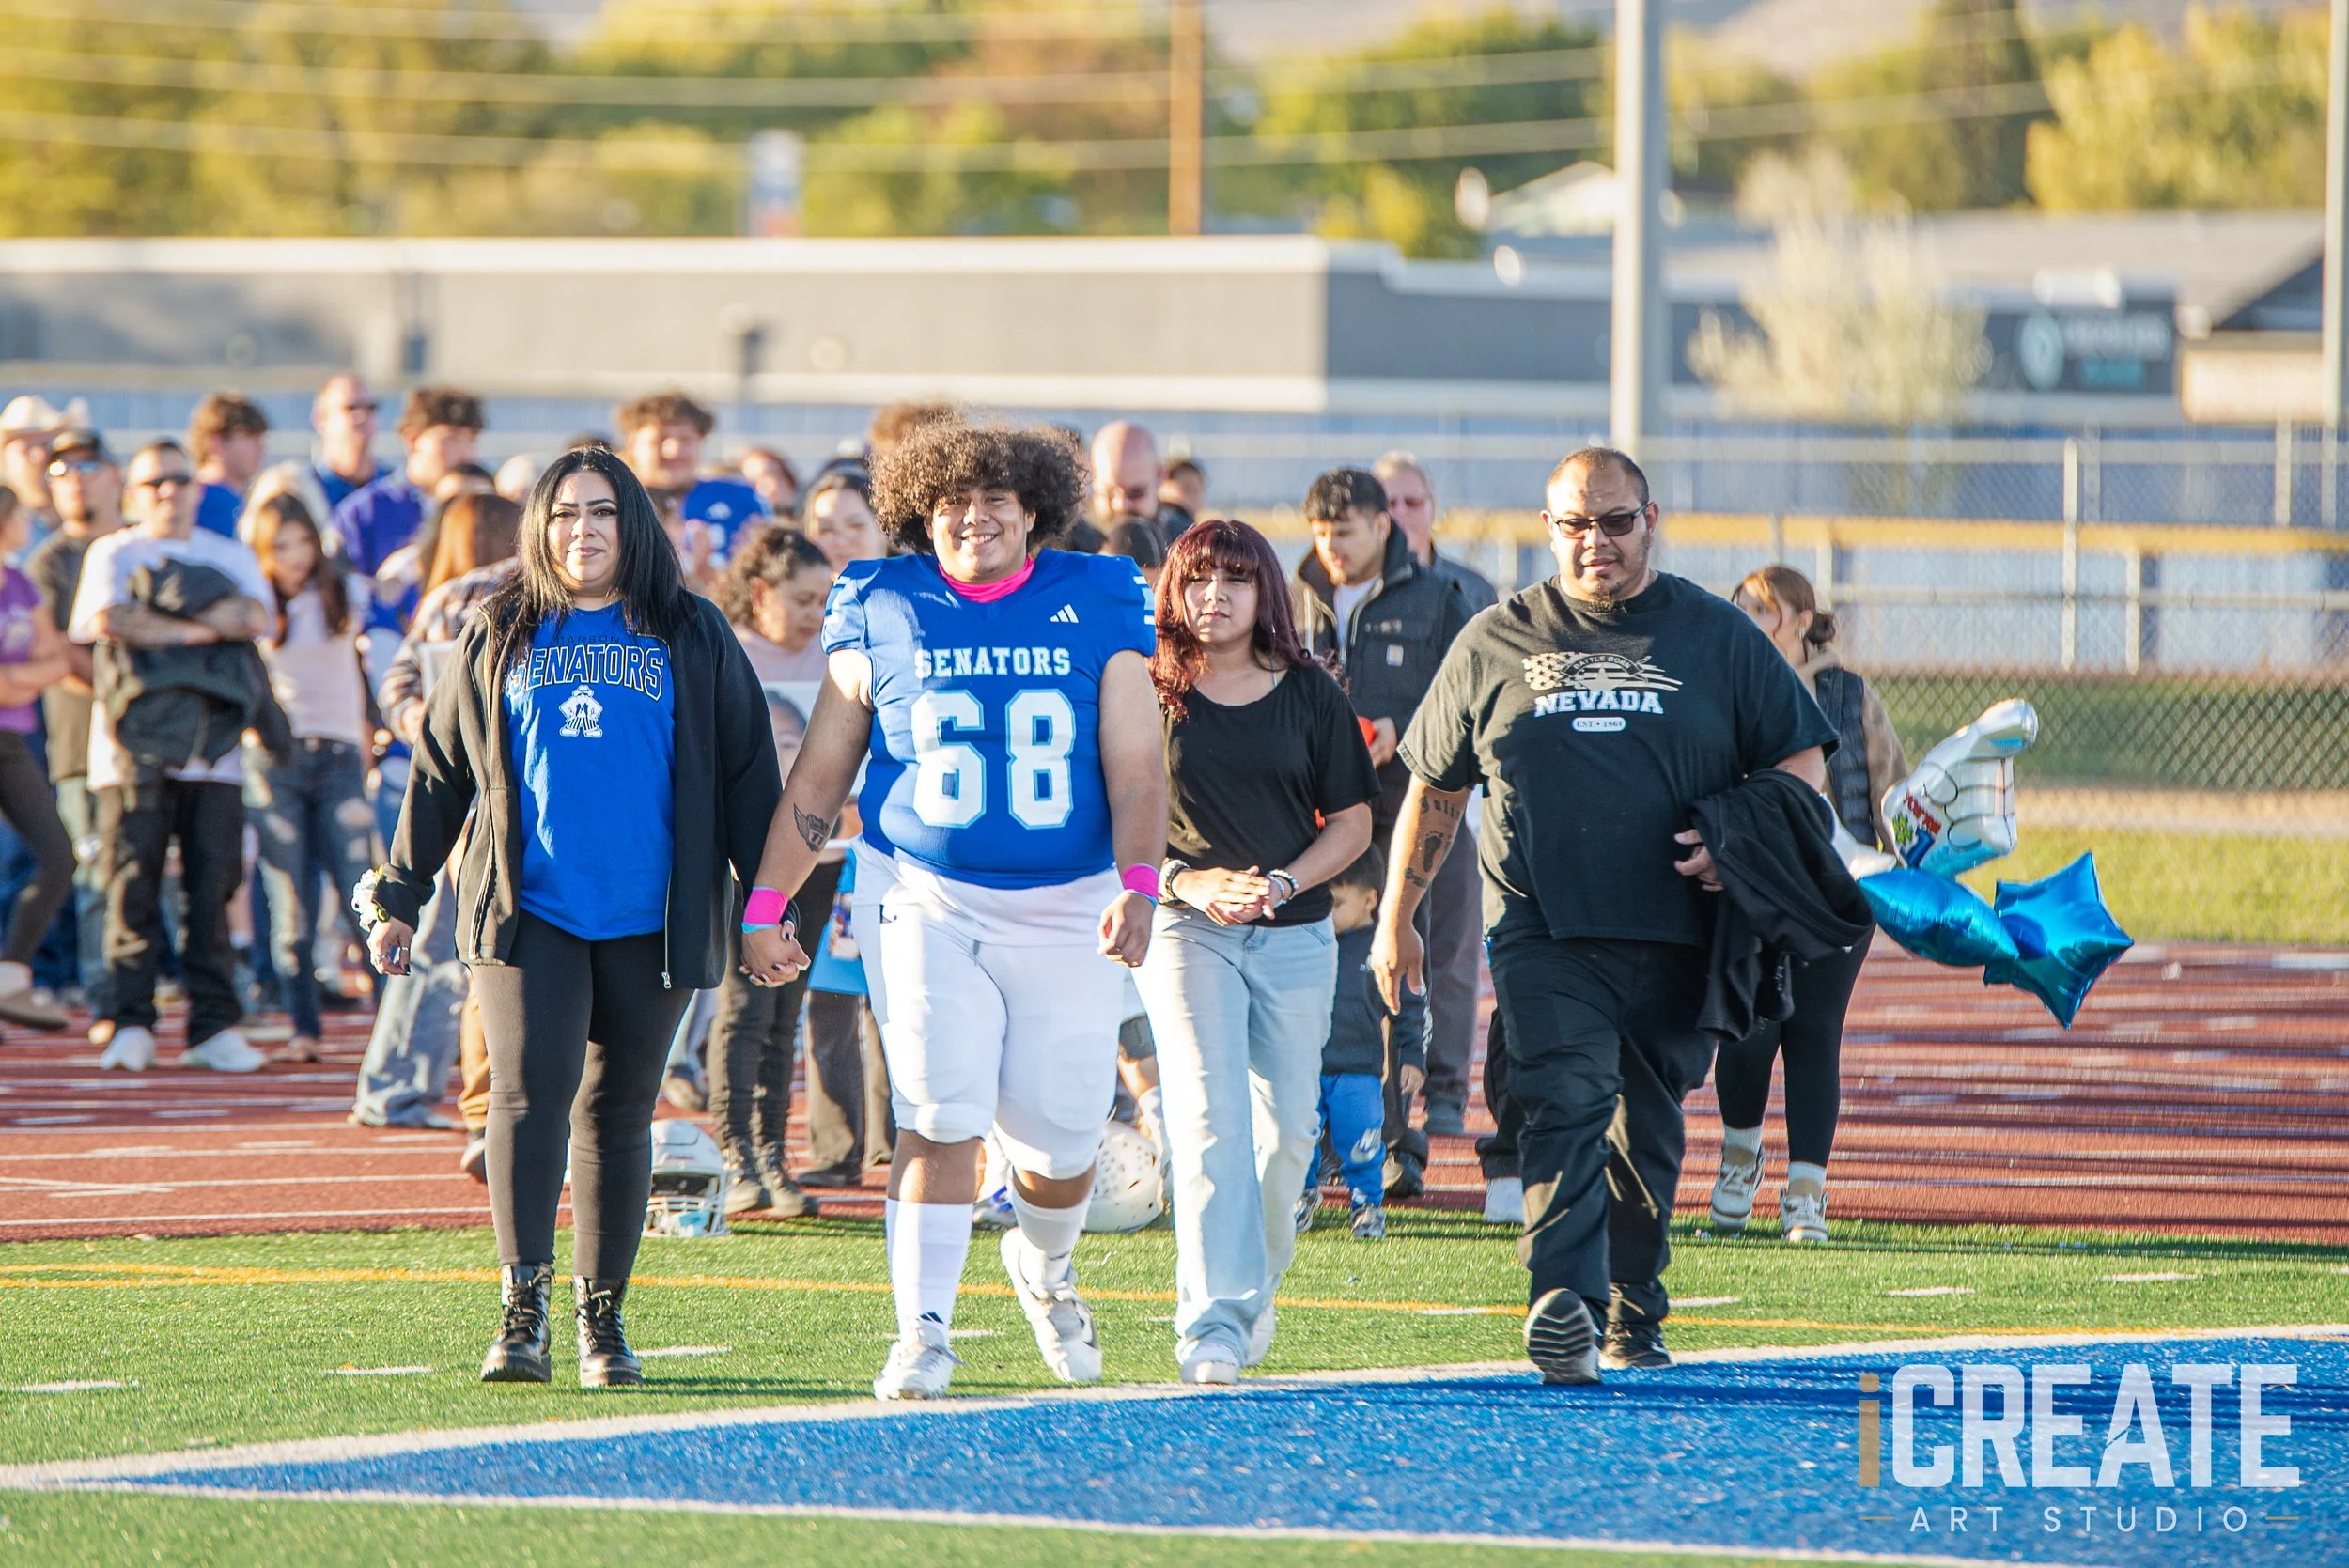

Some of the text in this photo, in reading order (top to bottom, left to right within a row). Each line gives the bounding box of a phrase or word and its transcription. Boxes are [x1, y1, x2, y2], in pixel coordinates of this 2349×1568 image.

[556, 634, 620, 645] CARSON
[506, 644, 663, 701] SENATORS
[914, 646, 1071, 678] SENATORS
[1573, 656, 1631, 669] BATTLE BORN
[1533, 690, 1664, 718] NEVADA
[910, 688, 1077, 831] 68
